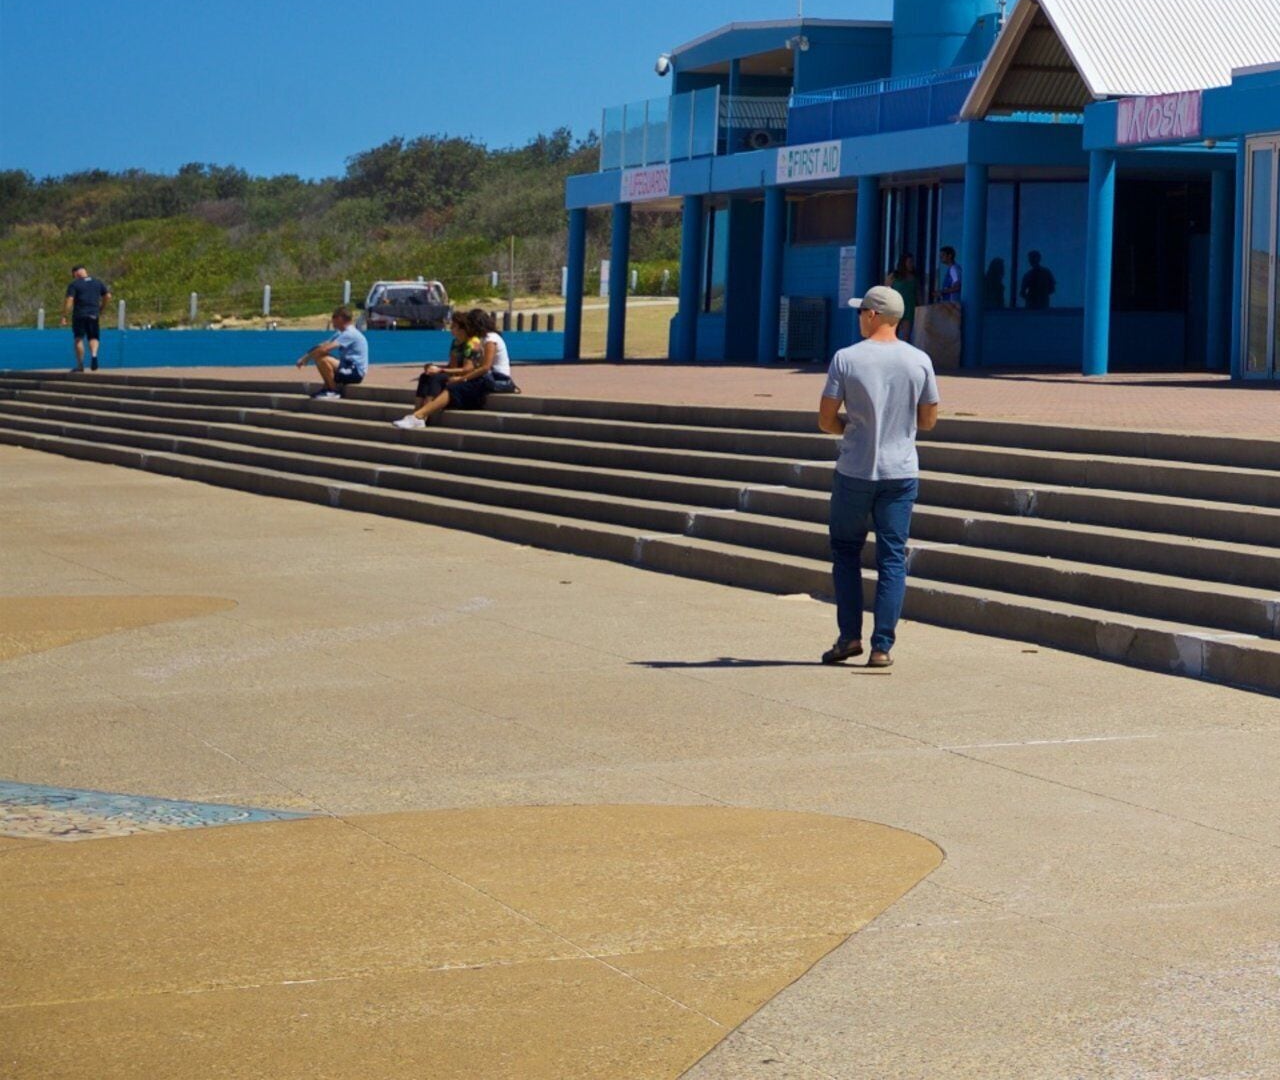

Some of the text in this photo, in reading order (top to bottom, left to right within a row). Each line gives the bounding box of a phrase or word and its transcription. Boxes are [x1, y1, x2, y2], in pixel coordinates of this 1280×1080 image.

[793, 146, 839, 176] FIRST AID
[629, 167, 669, 196] LIFEGUARDS
